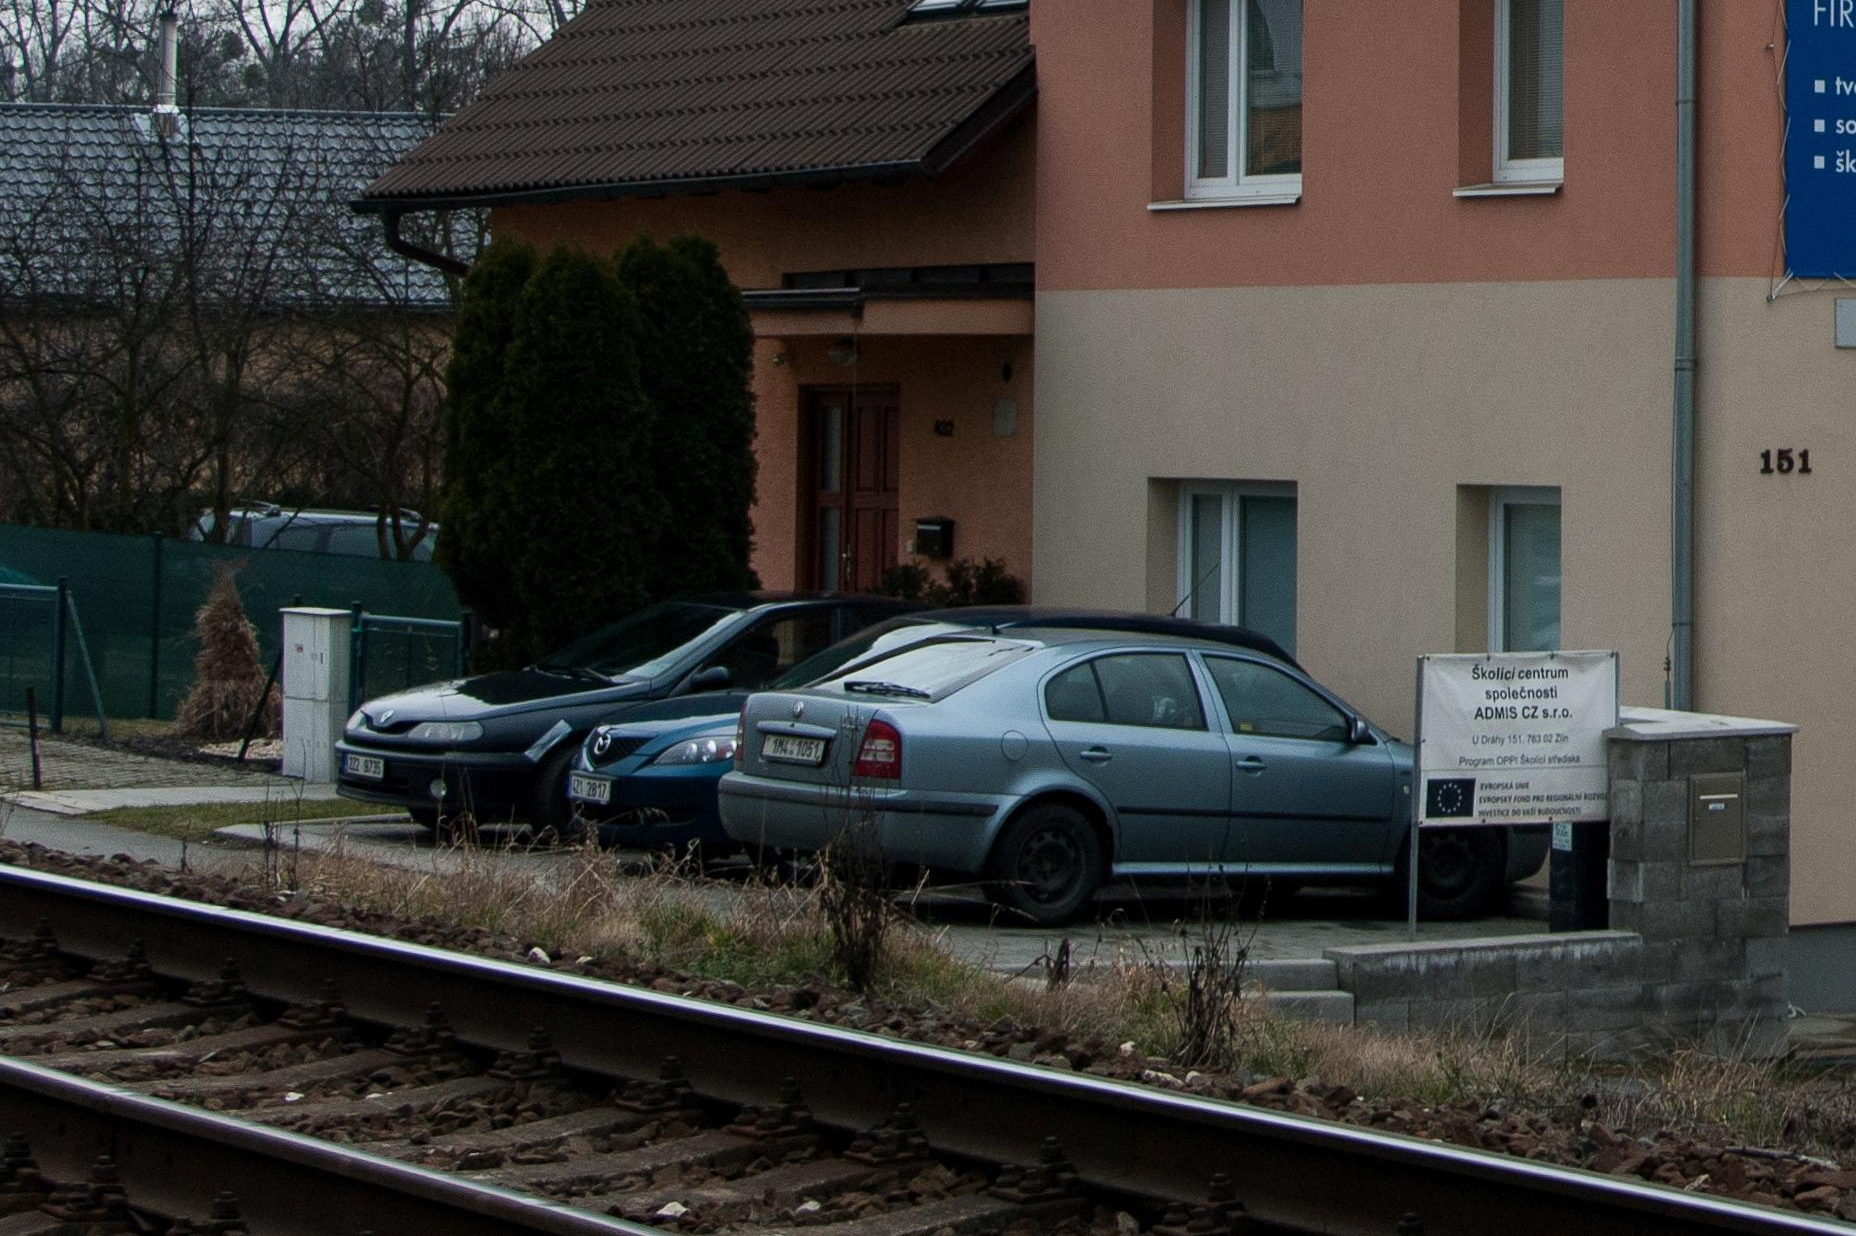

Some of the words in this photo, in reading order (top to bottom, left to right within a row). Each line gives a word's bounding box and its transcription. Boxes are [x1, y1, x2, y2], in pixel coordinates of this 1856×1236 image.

[1760, 448, 1812, 474] 151
[1517, 666, 1569, 680] centrum
[1485, 685, 1558, 703] společnosti
[1474, 706, 1518, 720] ADMIS
[1521, 705, 1539, 719] CZ
[1542, 708, 1573, 719] s.r.o.
[1472, 735, 1479, 745] U
[1508, 734, 1524, 745] 151,
[1527, 733, 1541, 744] 763
[1543, 733, 1553, 743] 02
[1459, 756, 1494, 768] Program
